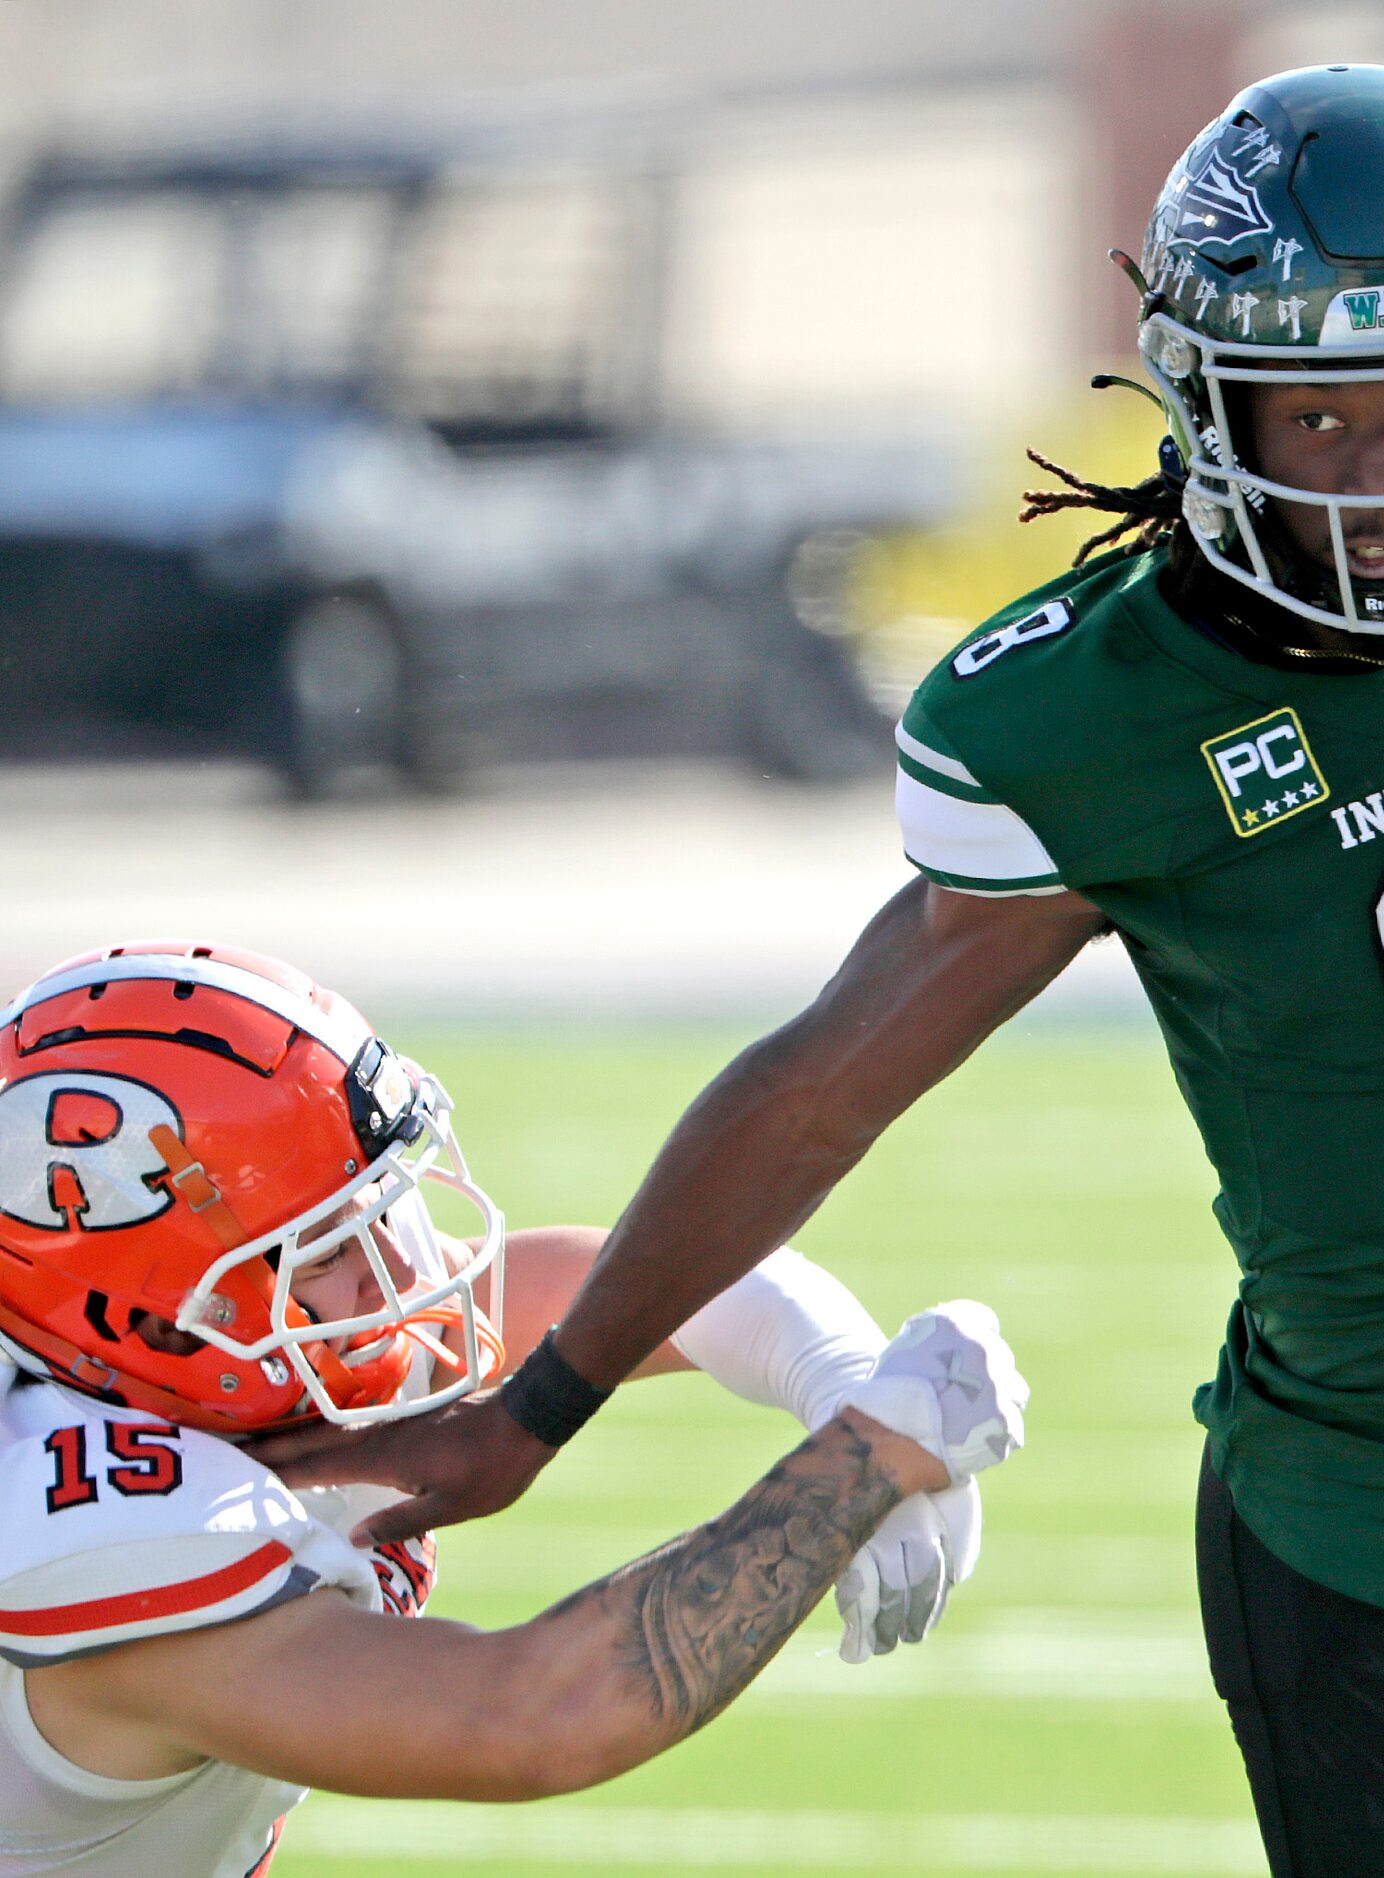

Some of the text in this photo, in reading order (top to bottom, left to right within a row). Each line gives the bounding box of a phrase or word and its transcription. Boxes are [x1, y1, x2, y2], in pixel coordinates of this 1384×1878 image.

[951, 597, 1074, 680] 8
[1214, 724, 1306, 797] PC
[0, 1069, 186, 1232] R
[43, 1420, 183, 1515] 15
